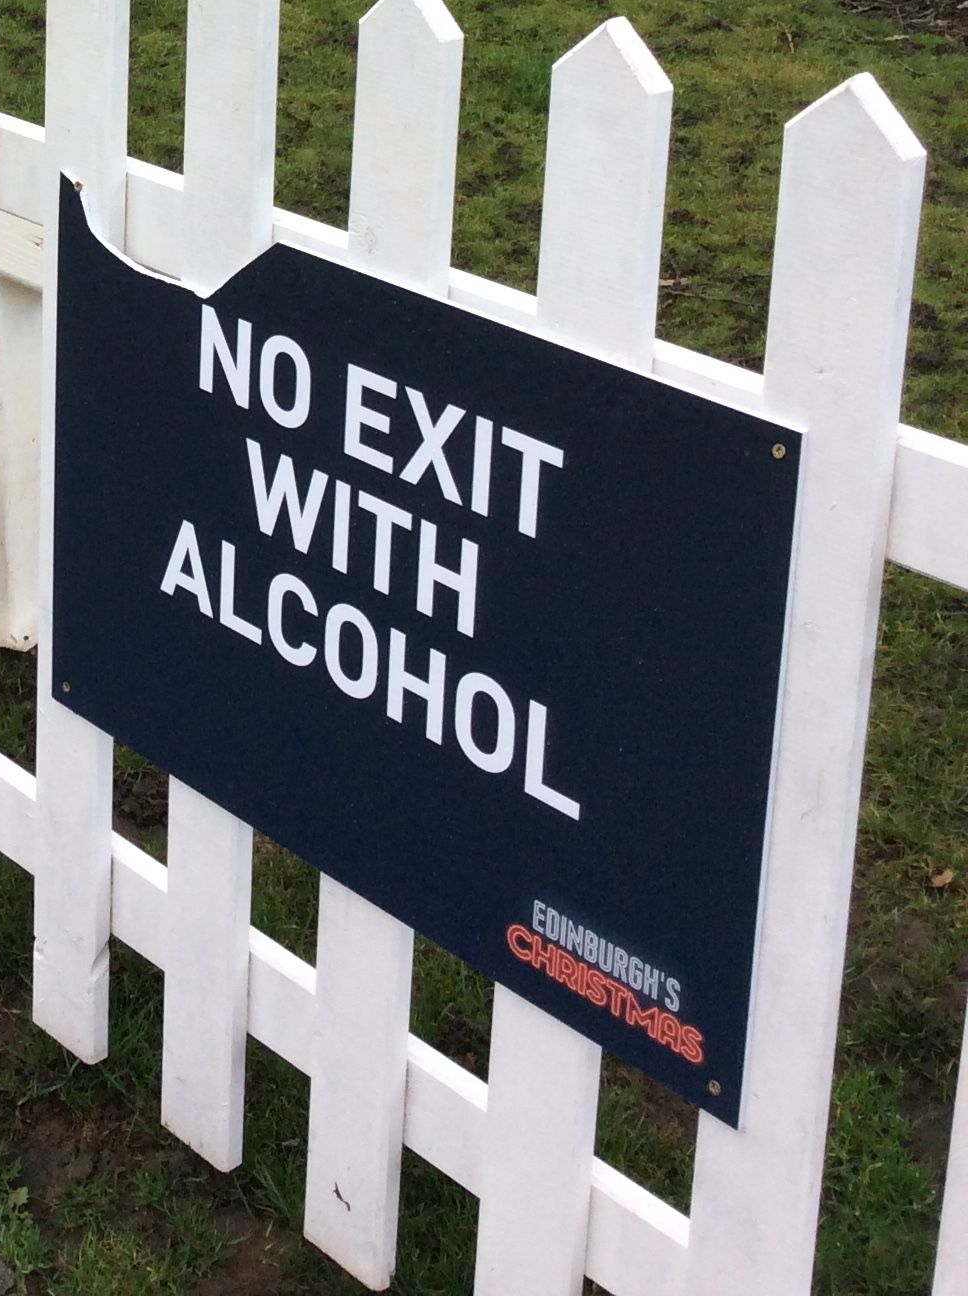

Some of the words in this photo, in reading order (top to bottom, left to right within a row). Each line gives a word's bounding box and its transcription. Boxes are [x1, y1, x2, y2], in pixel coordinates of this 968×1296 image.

[199, 303, 311, 429] NO
[343, 363, 564, 538] EXIT
[245, 437, 479, 639] WITH
[159, 519, 581, 821] ALCOHOL
[506, 922, 705, 1064] CHRISTMAS
[532, 899, 681, 1012] EDINBURGH'S
